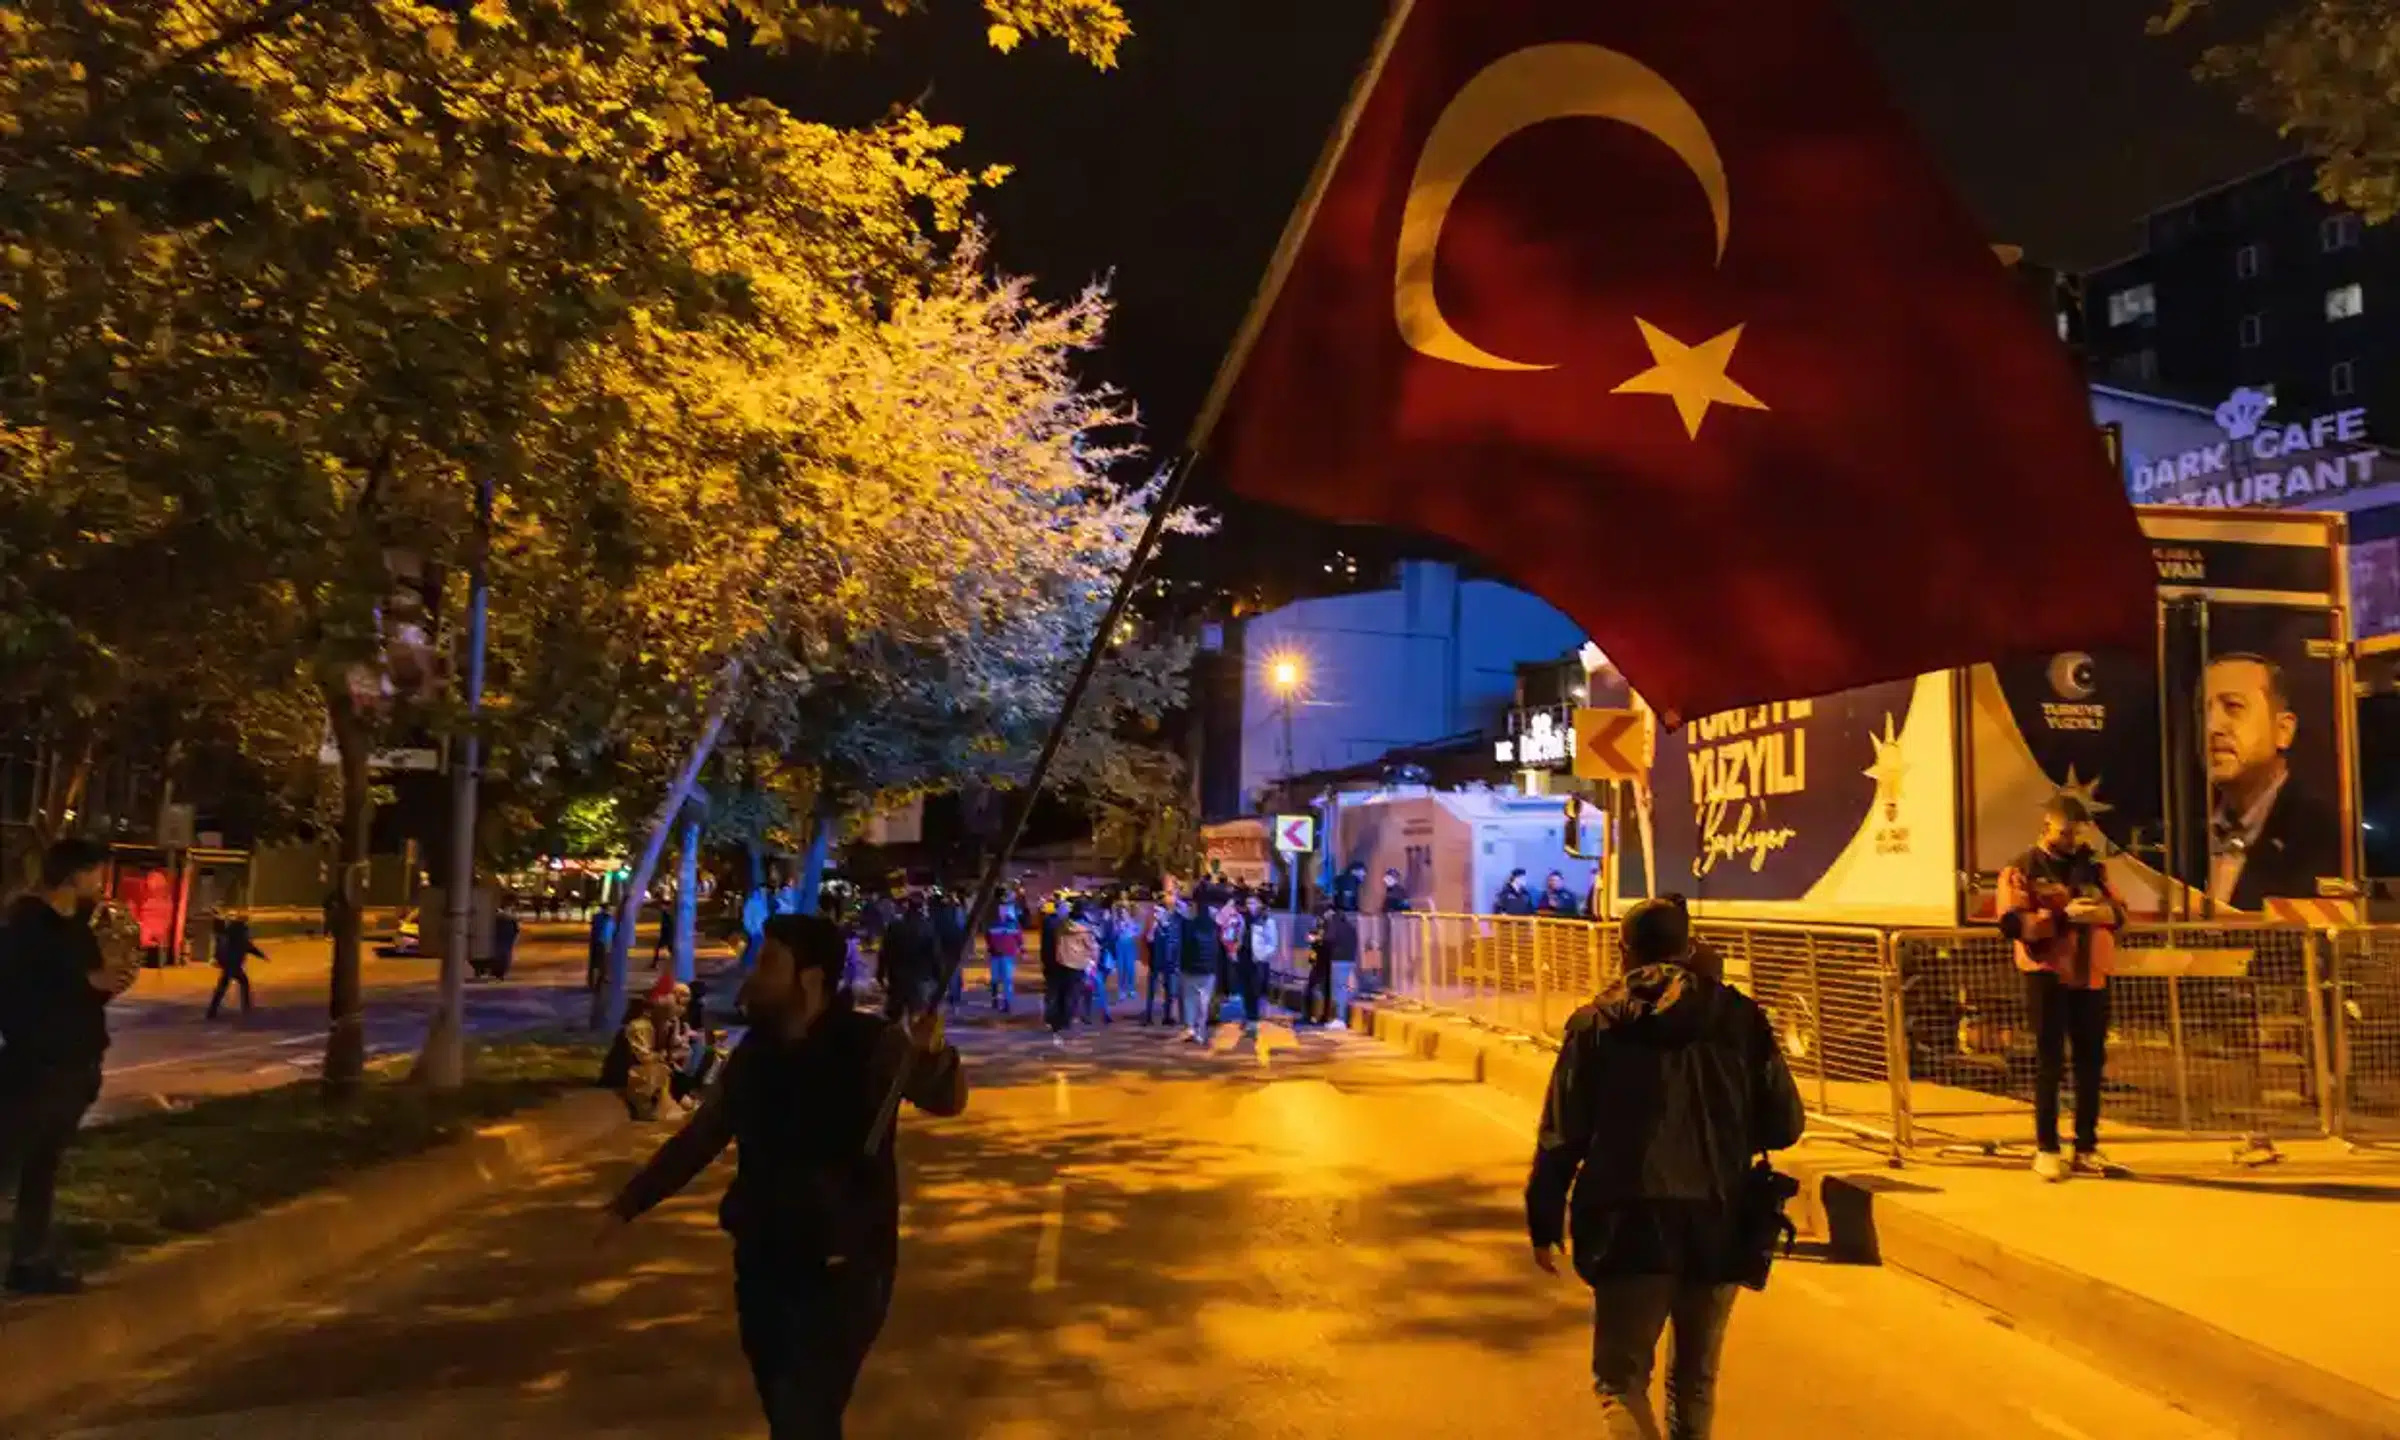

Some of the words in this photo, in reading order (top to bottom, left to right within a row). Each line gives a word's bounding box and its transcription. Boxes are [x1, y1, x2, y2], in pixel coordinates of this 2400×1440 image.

[2133, 443, 2227, 493] DARK
[2253, 408, 2367, 459] CAFE
[2164, 450, 2380, 508] TAURANT
